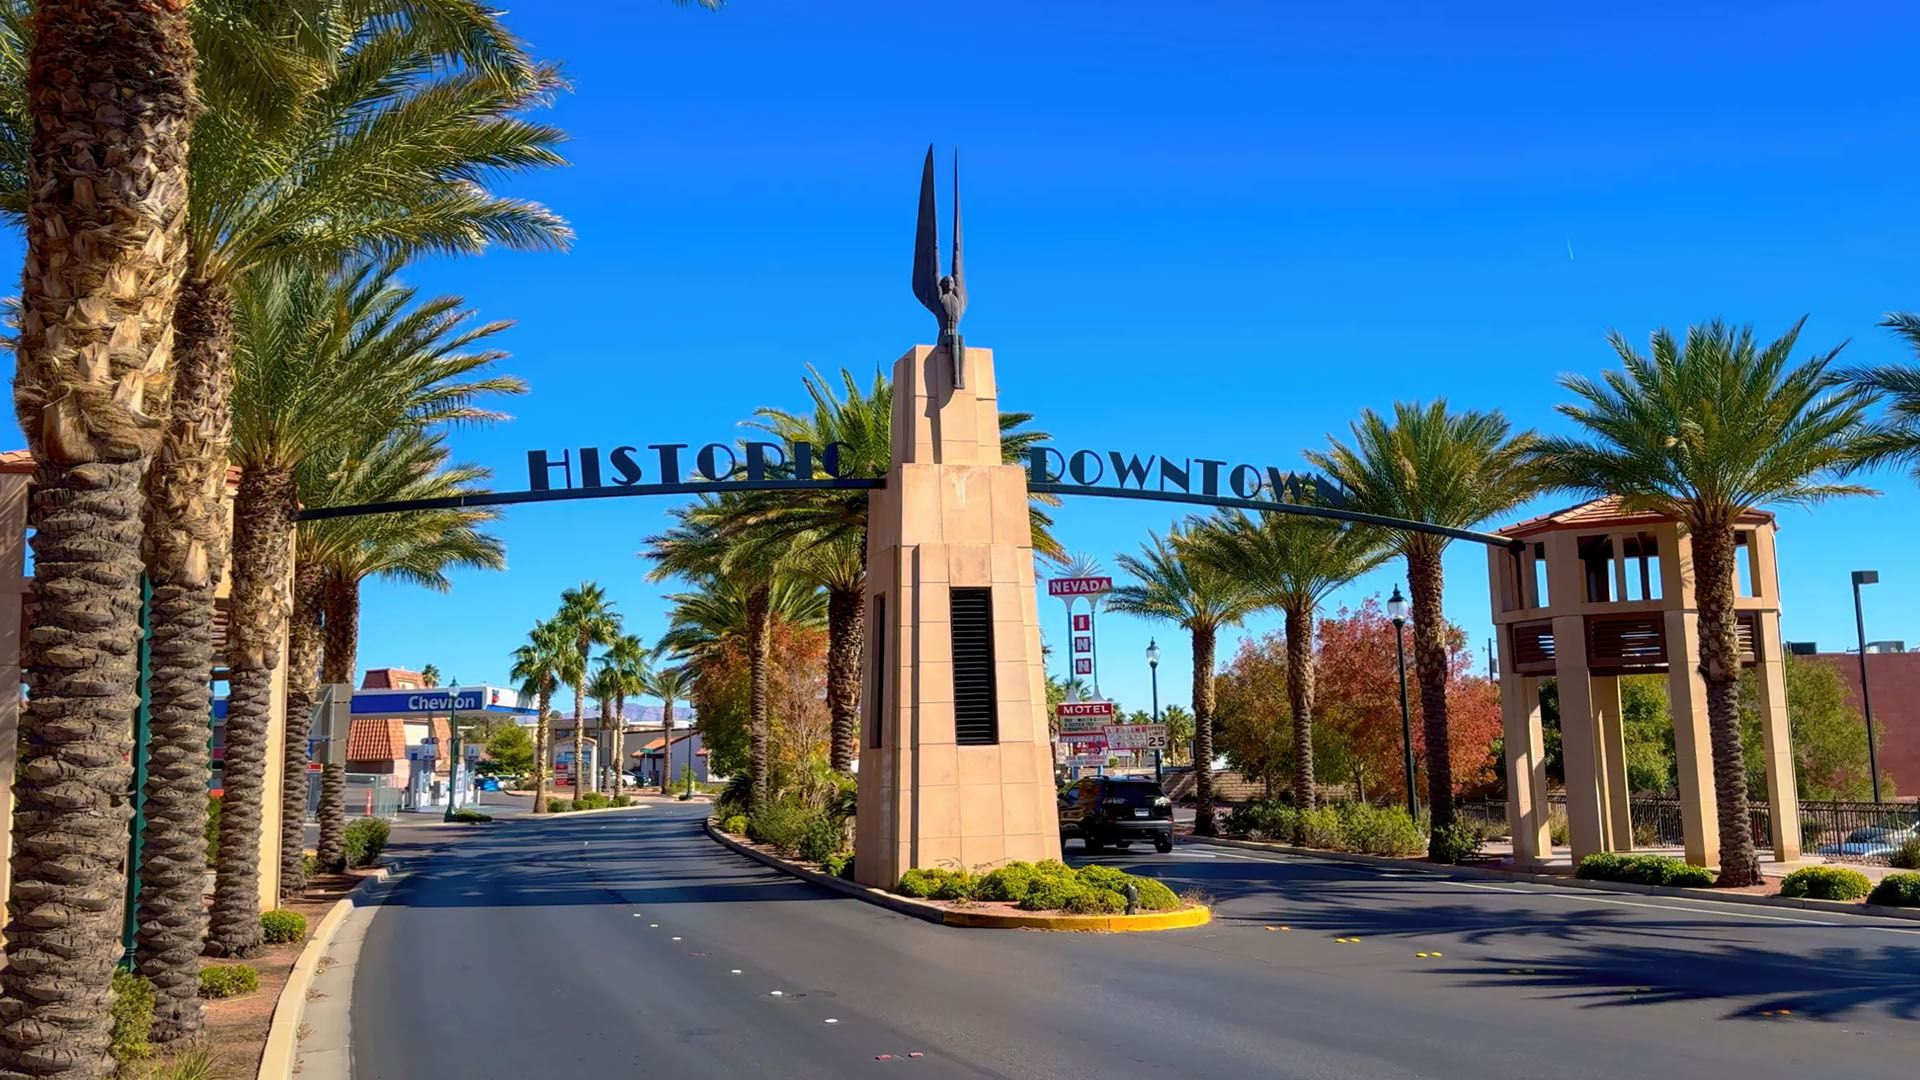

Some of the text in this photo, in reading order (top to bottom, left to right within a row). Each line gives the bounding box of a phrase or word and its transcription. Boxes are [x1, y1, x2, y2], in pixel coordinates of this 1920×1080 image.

[527, 442, 1345, 510] HISTORIC DOWNTOWN
[1051, 579, 1111, 594] NEVADA
[1076, 617, 1090, 673] INN
[1063, 704, 1110, 715] MOTEL
[1148, 736, 1166, 748] 25
